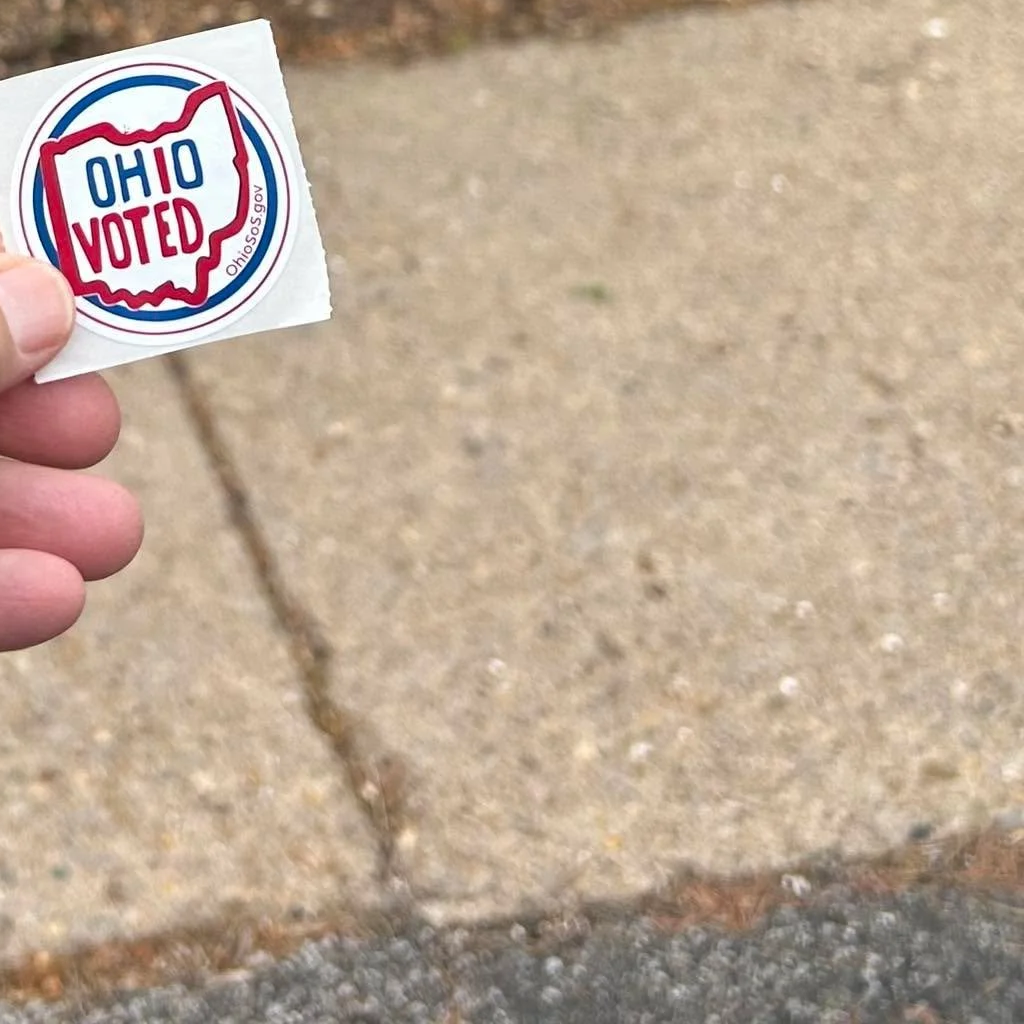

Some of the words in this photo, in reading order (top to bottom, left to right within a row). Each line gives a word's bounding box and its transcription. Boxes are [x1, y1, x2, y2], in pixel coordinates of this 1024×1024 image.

[85, 138, 204, 208] OHIO
[71, 197, 204, 274] VOTED
[226, 184, 266, 277] OhioSoS.gov
